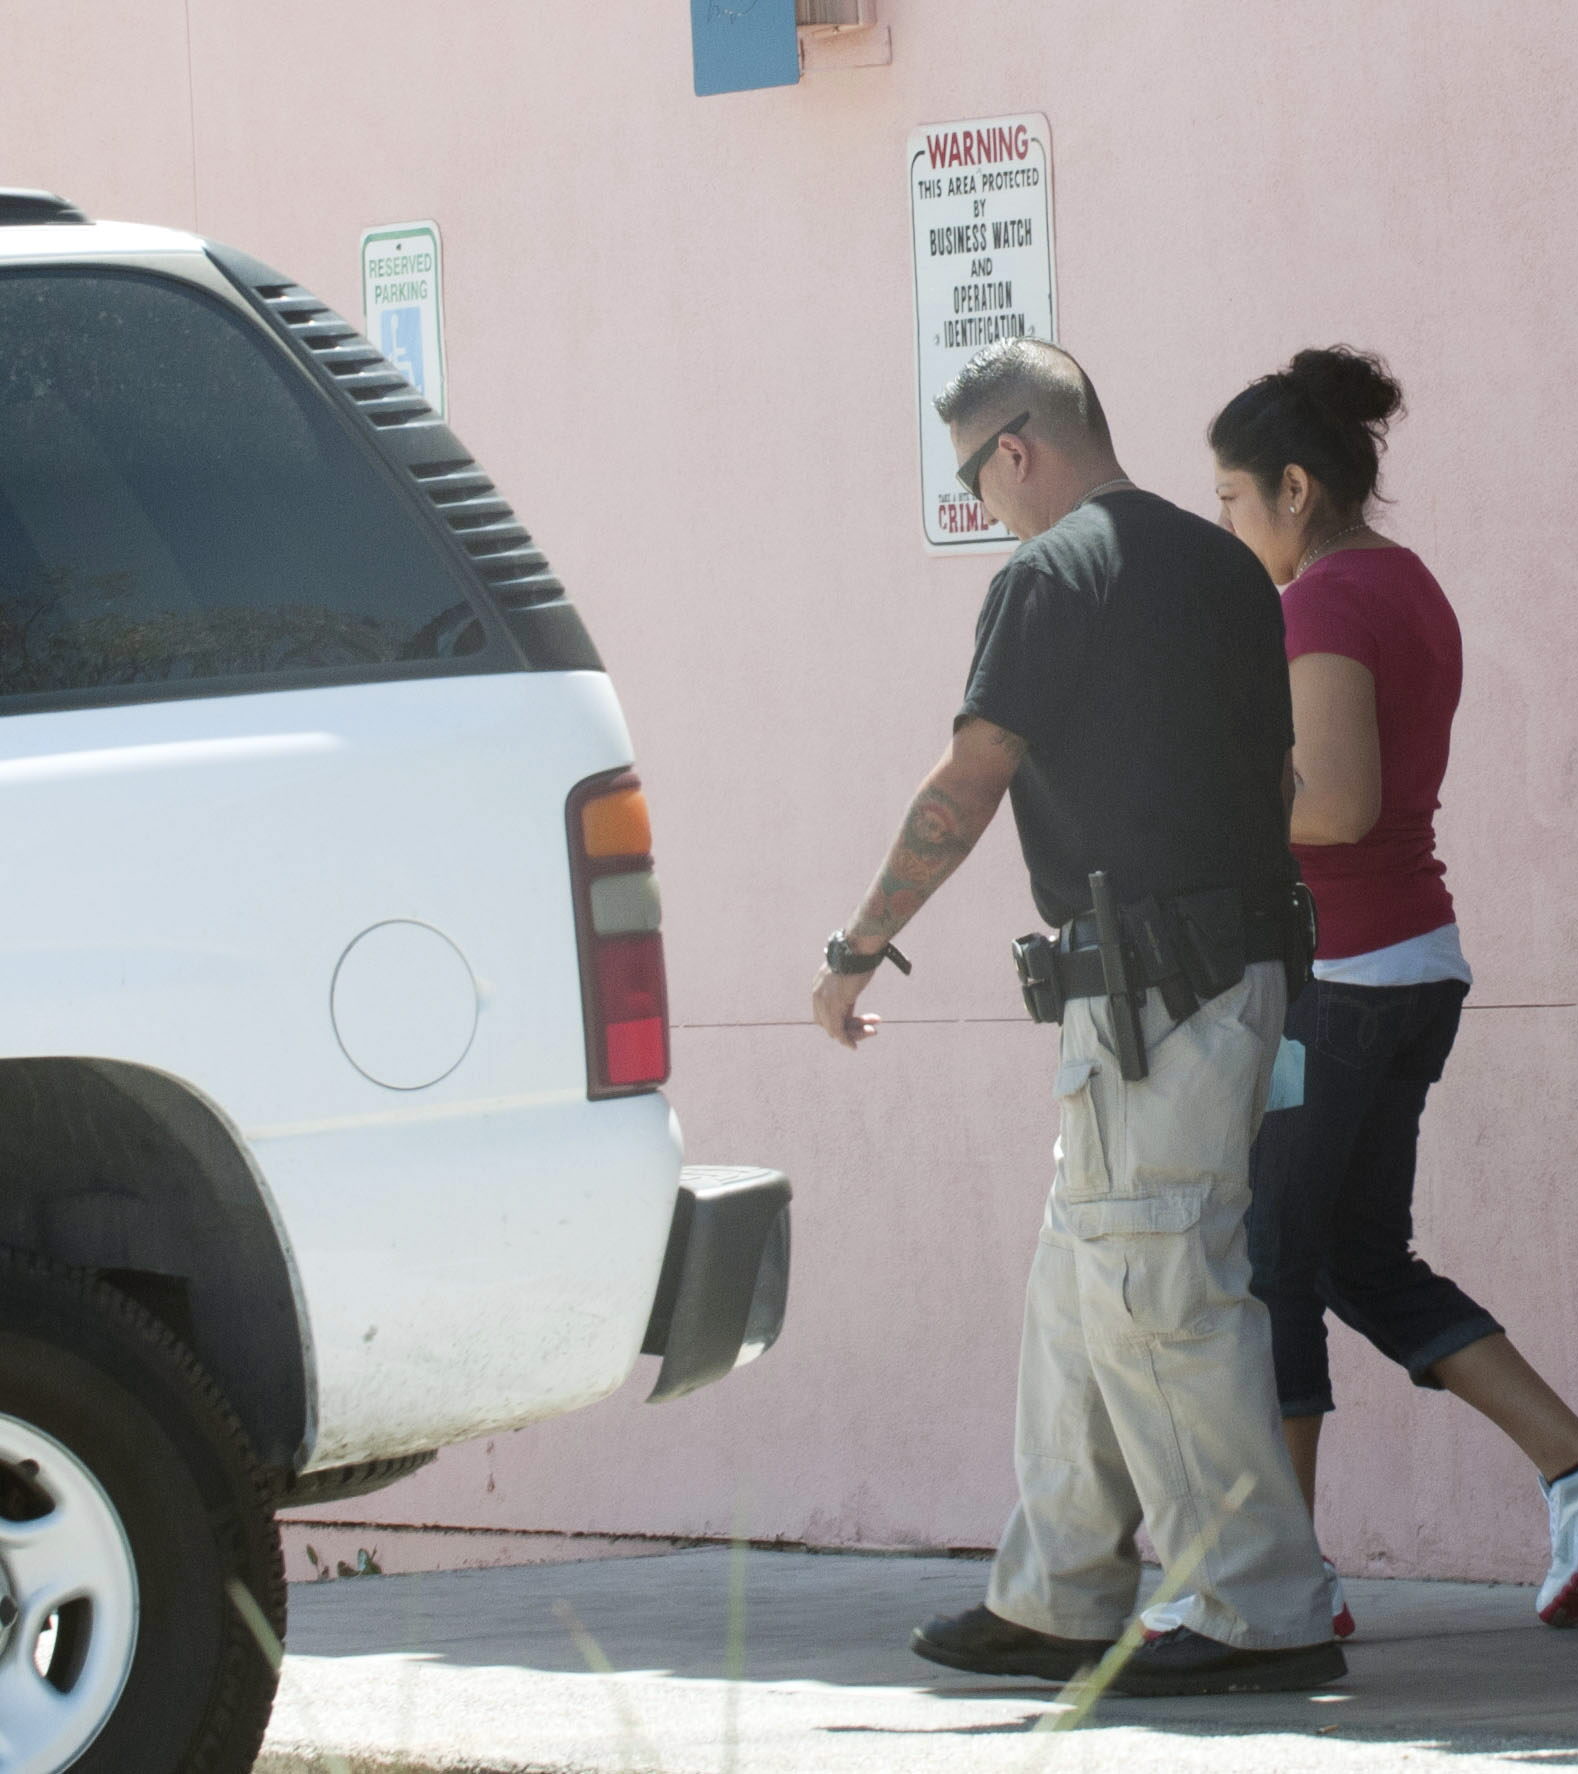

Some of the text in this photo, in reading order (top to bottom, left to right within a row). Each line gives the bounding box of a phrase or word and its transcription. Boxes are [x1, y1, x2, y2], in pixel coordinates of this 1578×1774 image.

[926, 124, 1030, 170] WARNING
[918, 167, 1039, 200] THIS AREA PROTECTED
[973, 199, 986, 218] BY
[929, 218, 1032, 257] BUSINESS WATCH
[368, 253, 432, 279] RESERVED
[970, 258, 993, 278] AND
[374, 280, 428, 305] PARKING
[953, 281, 1013, 314] OPERATION
[943, 313, 1025, 348] IDENTIFICATION
